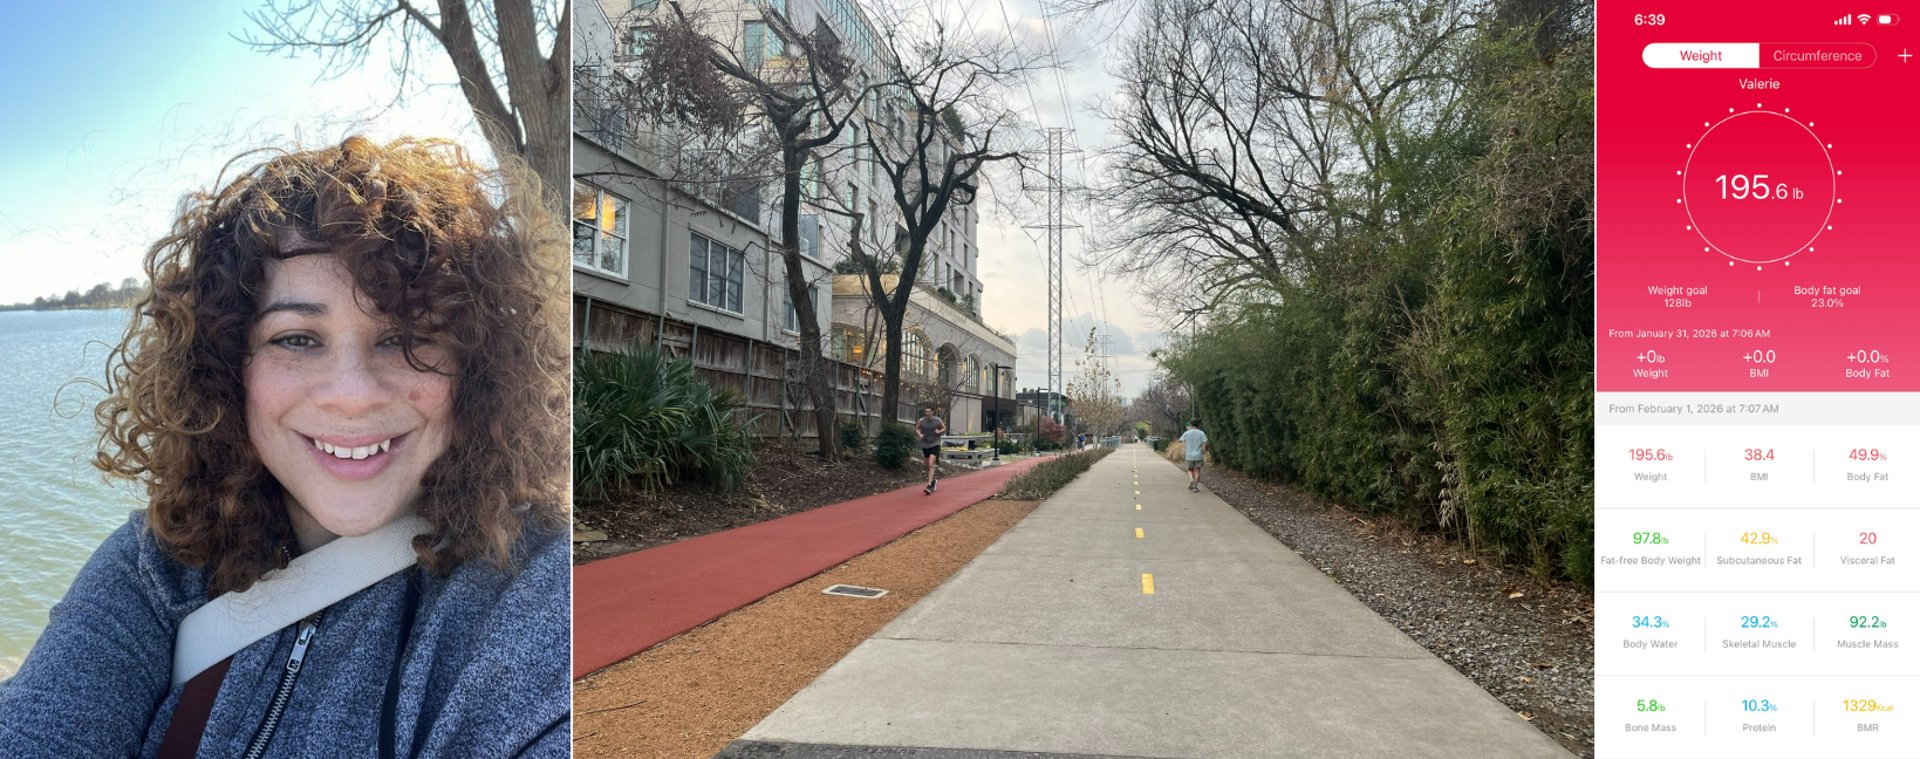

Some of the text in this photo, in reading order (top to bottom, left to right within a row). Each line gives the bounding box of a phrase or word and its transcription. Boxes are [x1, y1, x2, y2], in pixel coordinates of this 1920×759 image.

[1634, 14, 1665, 26] 6:39
[1679, 49, 1723, 64] Weight
[1773, 49, 1862, 62] Circumference
[1739, 78, 1781, 90] Valerie
[1715, 174, 1804, 200] 195.6 lb
[1647, 285, 1708, 298] Weight goal
[1793, 285, 1861, 298] Body fat goal
[1664, 298, 1692, 309] 128lb
[1811, 298, 1844, 309] 23.0%
[1608, 329, 1771, 341] From January 31, 2026 at 7:06 AM
[1636, 349, 1666, 364] +0lb
[1742, 349, 1776, 364] +0.0
[1846, 349, 1889, 364] +0.0%
[1633, 368, 1669, 380] Weight
[1749, 368, 1769, 378] BMI
[1845, 368, 1890, 380] Body Fat
[1608, 403, 1779, 416] From February 1, 2026 at 7:07 AM
[1629, 448, 1674, 461] 195.6lb
[1744, 448, 1775, 461] 38.4
[1848, 448, 1888, 461] 49.9%
[1634, 472, 1668, 484] Weight
[1750, 472, 1769, 481] BMI
[1847, 472, 1889, 484] Body Fat
[1632, 532, 1669, 545] 97.8lb
[1740, 532, 1779, 545] 42.9%
[1859, 532, 1877, 545] 20
[1600, 556, 1701, 567] Fat-free Body Weight
[1717, 556, 1803, 566] Subcutaneous Fat
[1840, 556, 1896, 566] Visceral Fat
[1632, 615, 1670, 629] 34.3%
[1741, 615, 1779, 629] 29.2%
[1849, 615, 1887, 629] 92.2lb
[1623, 639, 1678, 651] Body Water
[1722, 639, 1797, 649] Skeletal Muscle
[1837, 639, 1899, 649] Muscle Mass
[1637, 699, 1666, 712] 5.8lb
[1741, 699, 1778, 712] 10.3%
[1842, 699, 1894, 712] 1329Kcal
[1625, 723, 1677, 733] Bone Mass
[1742, 722, 1777, 733] Protein
[1857, 723, 1879, 733] BMR
